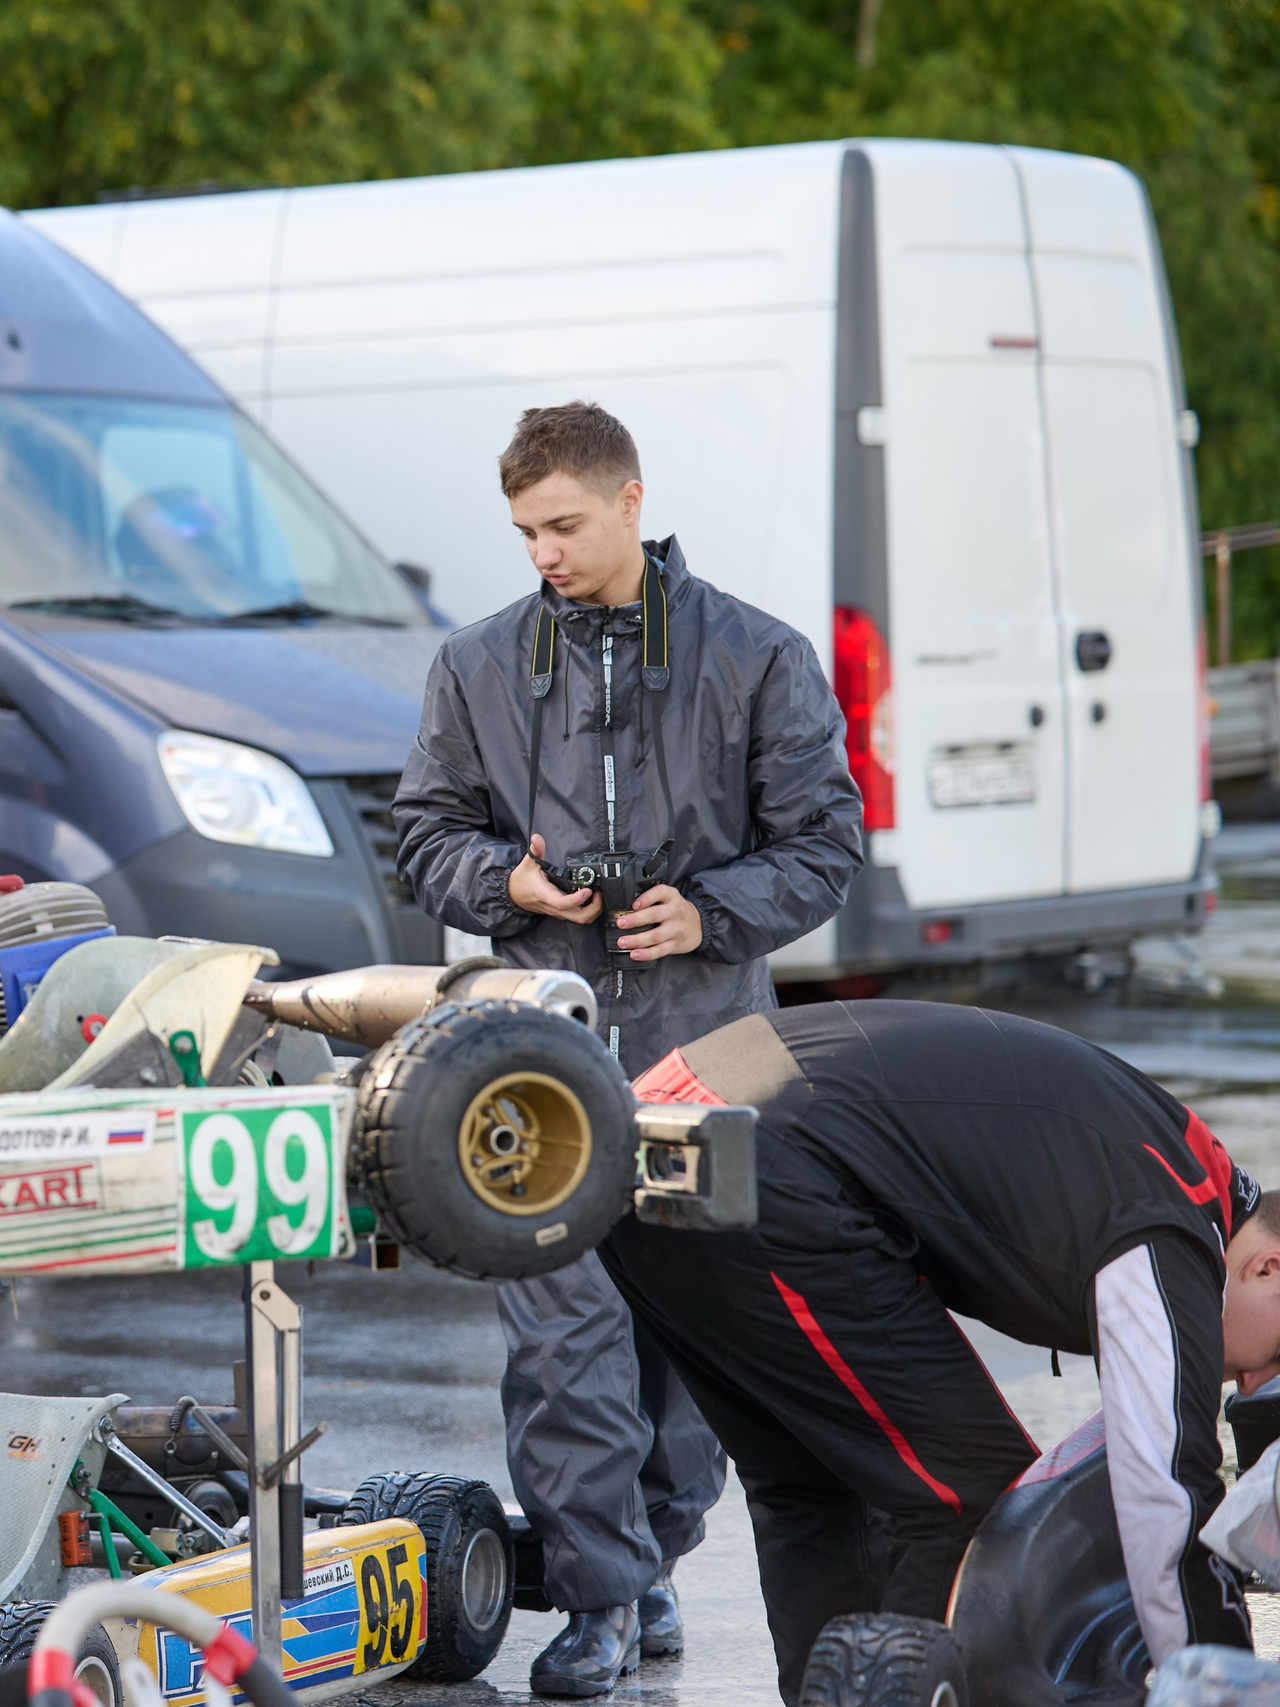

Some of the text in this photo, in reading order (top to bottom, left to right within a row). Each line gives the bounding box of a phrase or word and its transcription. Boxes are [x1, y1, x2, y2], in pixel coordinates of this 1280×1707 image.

[189, 1109, 324, 1260] 99
[303, 1570, 334, 1590] шевский
[361, 1543, 414, 1669] 95
